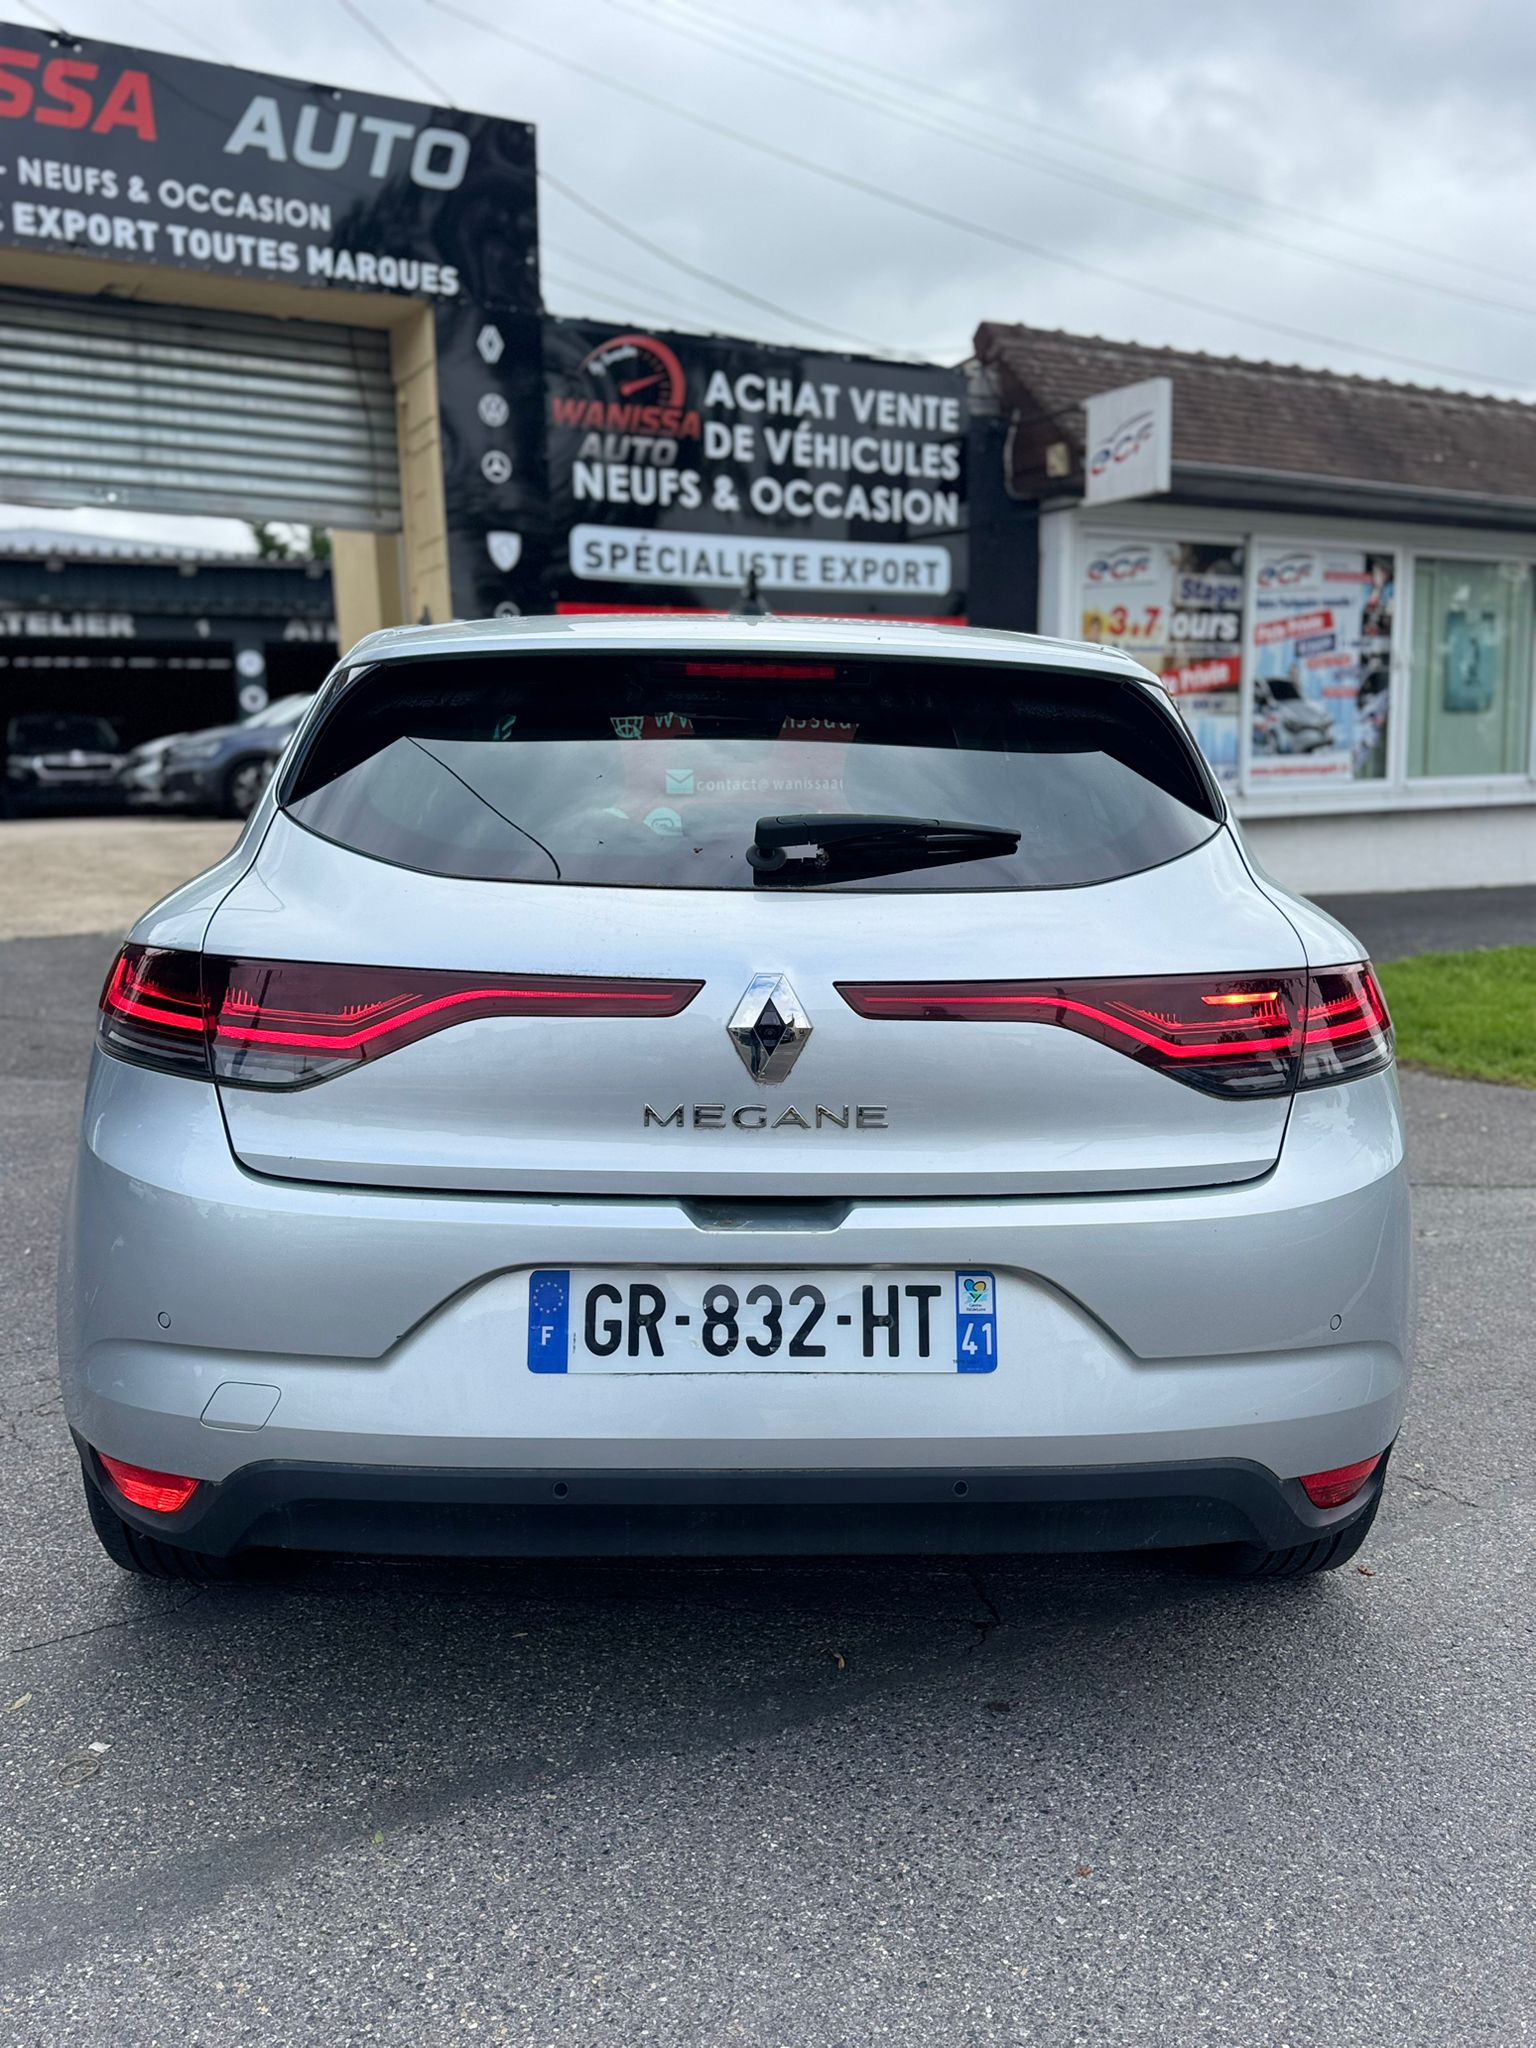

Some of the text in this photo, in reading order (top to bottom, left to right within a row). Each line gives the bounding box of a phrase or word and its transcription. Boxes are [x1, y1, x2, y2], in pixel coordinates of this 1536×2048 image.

[224, 95, 471, 191] AUTO
[17, 155, 331, 232] NEUFS & OCCASION
[12, 201, 459, 296] EXPORT TOUTES MARQUES
[552, 395, 700, 441] WANISSA
[705, 370, 960, 433] ACHAT VENTE
[577, 431, 678, 468] AUTO
[704, 422, 960, 481] DE VÉHICULES
[572, 462, 958, 526] NEUFS & OCCASION
[583, 535, 941, 588] SPÉCIALISTE EXPORT
[1182, 577, 1240, 609] Stage
[643, 1103, 889, 1129] MEGANE
[541, 1325, 555, 1346] F
[584, 1284, 942, 1358] GR-832-HT
[961, 1322, 993, 1356] 41
